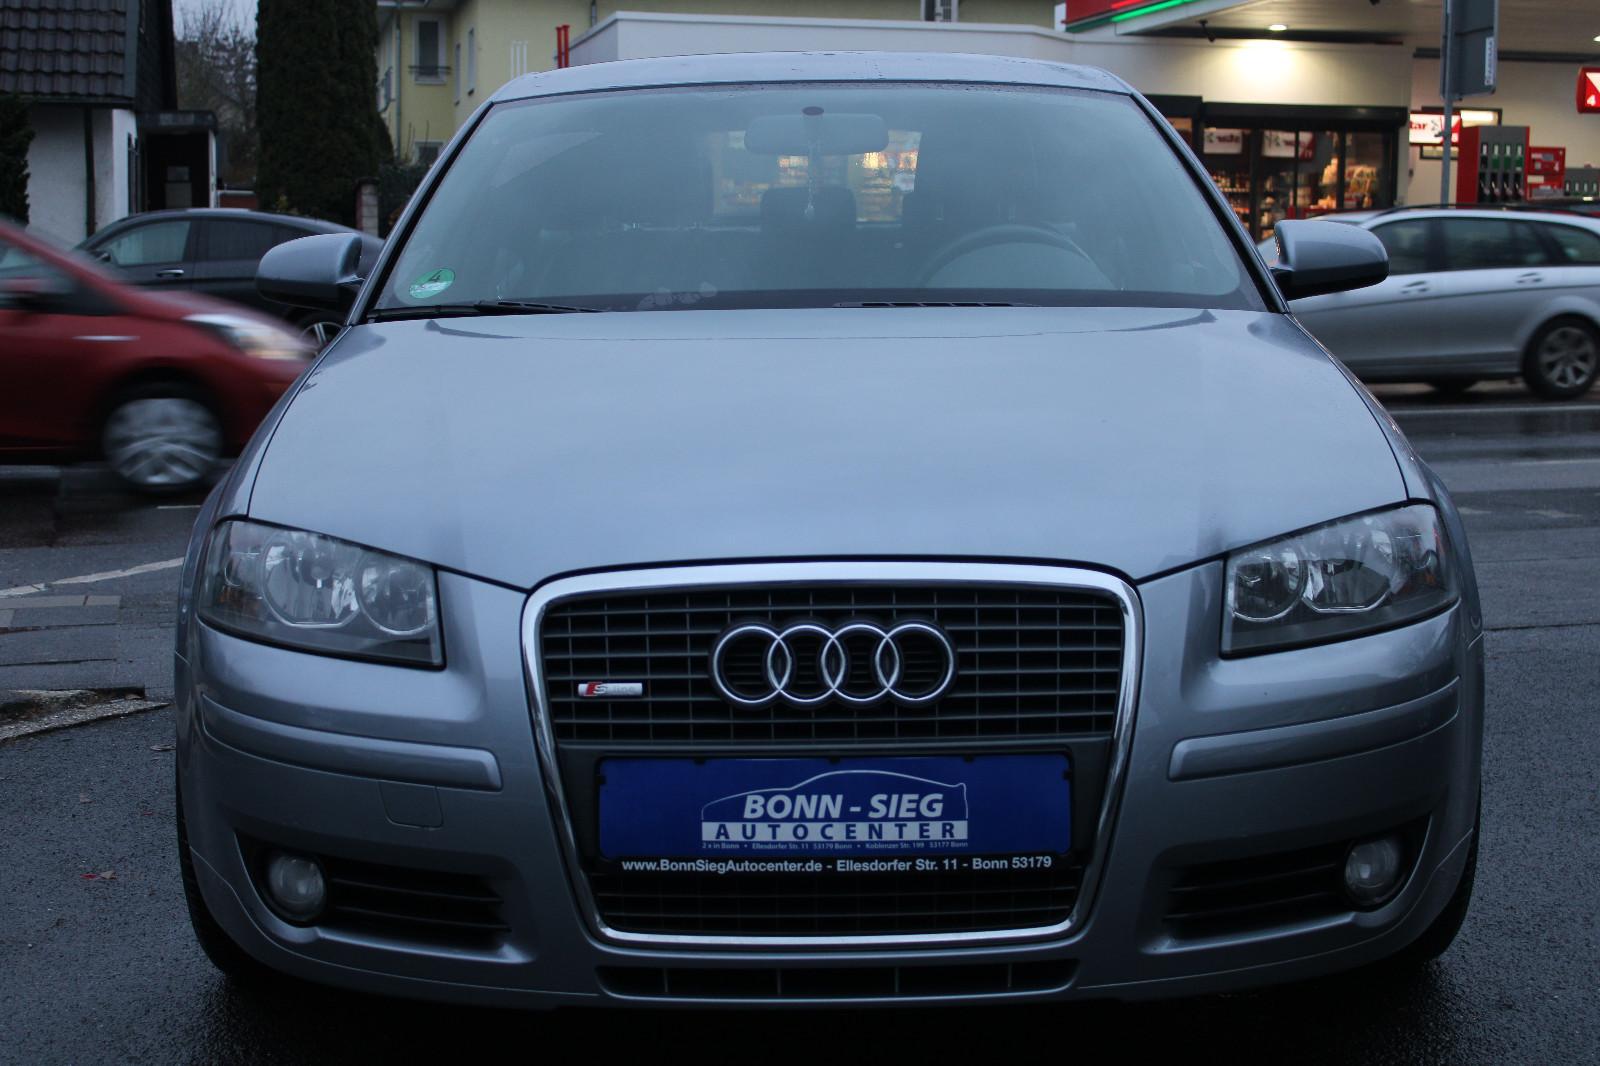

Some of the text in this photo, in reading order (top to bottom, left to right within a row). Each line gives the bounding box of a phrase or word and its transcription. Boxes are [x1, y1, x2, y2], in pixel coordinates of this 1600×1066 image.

[743, 793, 843, 819] BONN
[868, 792, 945, 819] SIEG
[715, 822, 955, 840] AUTOCENTER
[621, 858, 823, 874] www.BonnSiegAutocenter.de
[836, 859, 912, 872] Ellesdorfer
[915, 858, 939, 871] Str.
[943, 858, 958, 870] 11
[972, 857, 1009, 870] Bonn
[1012, 855, 1053, 869] 53179
